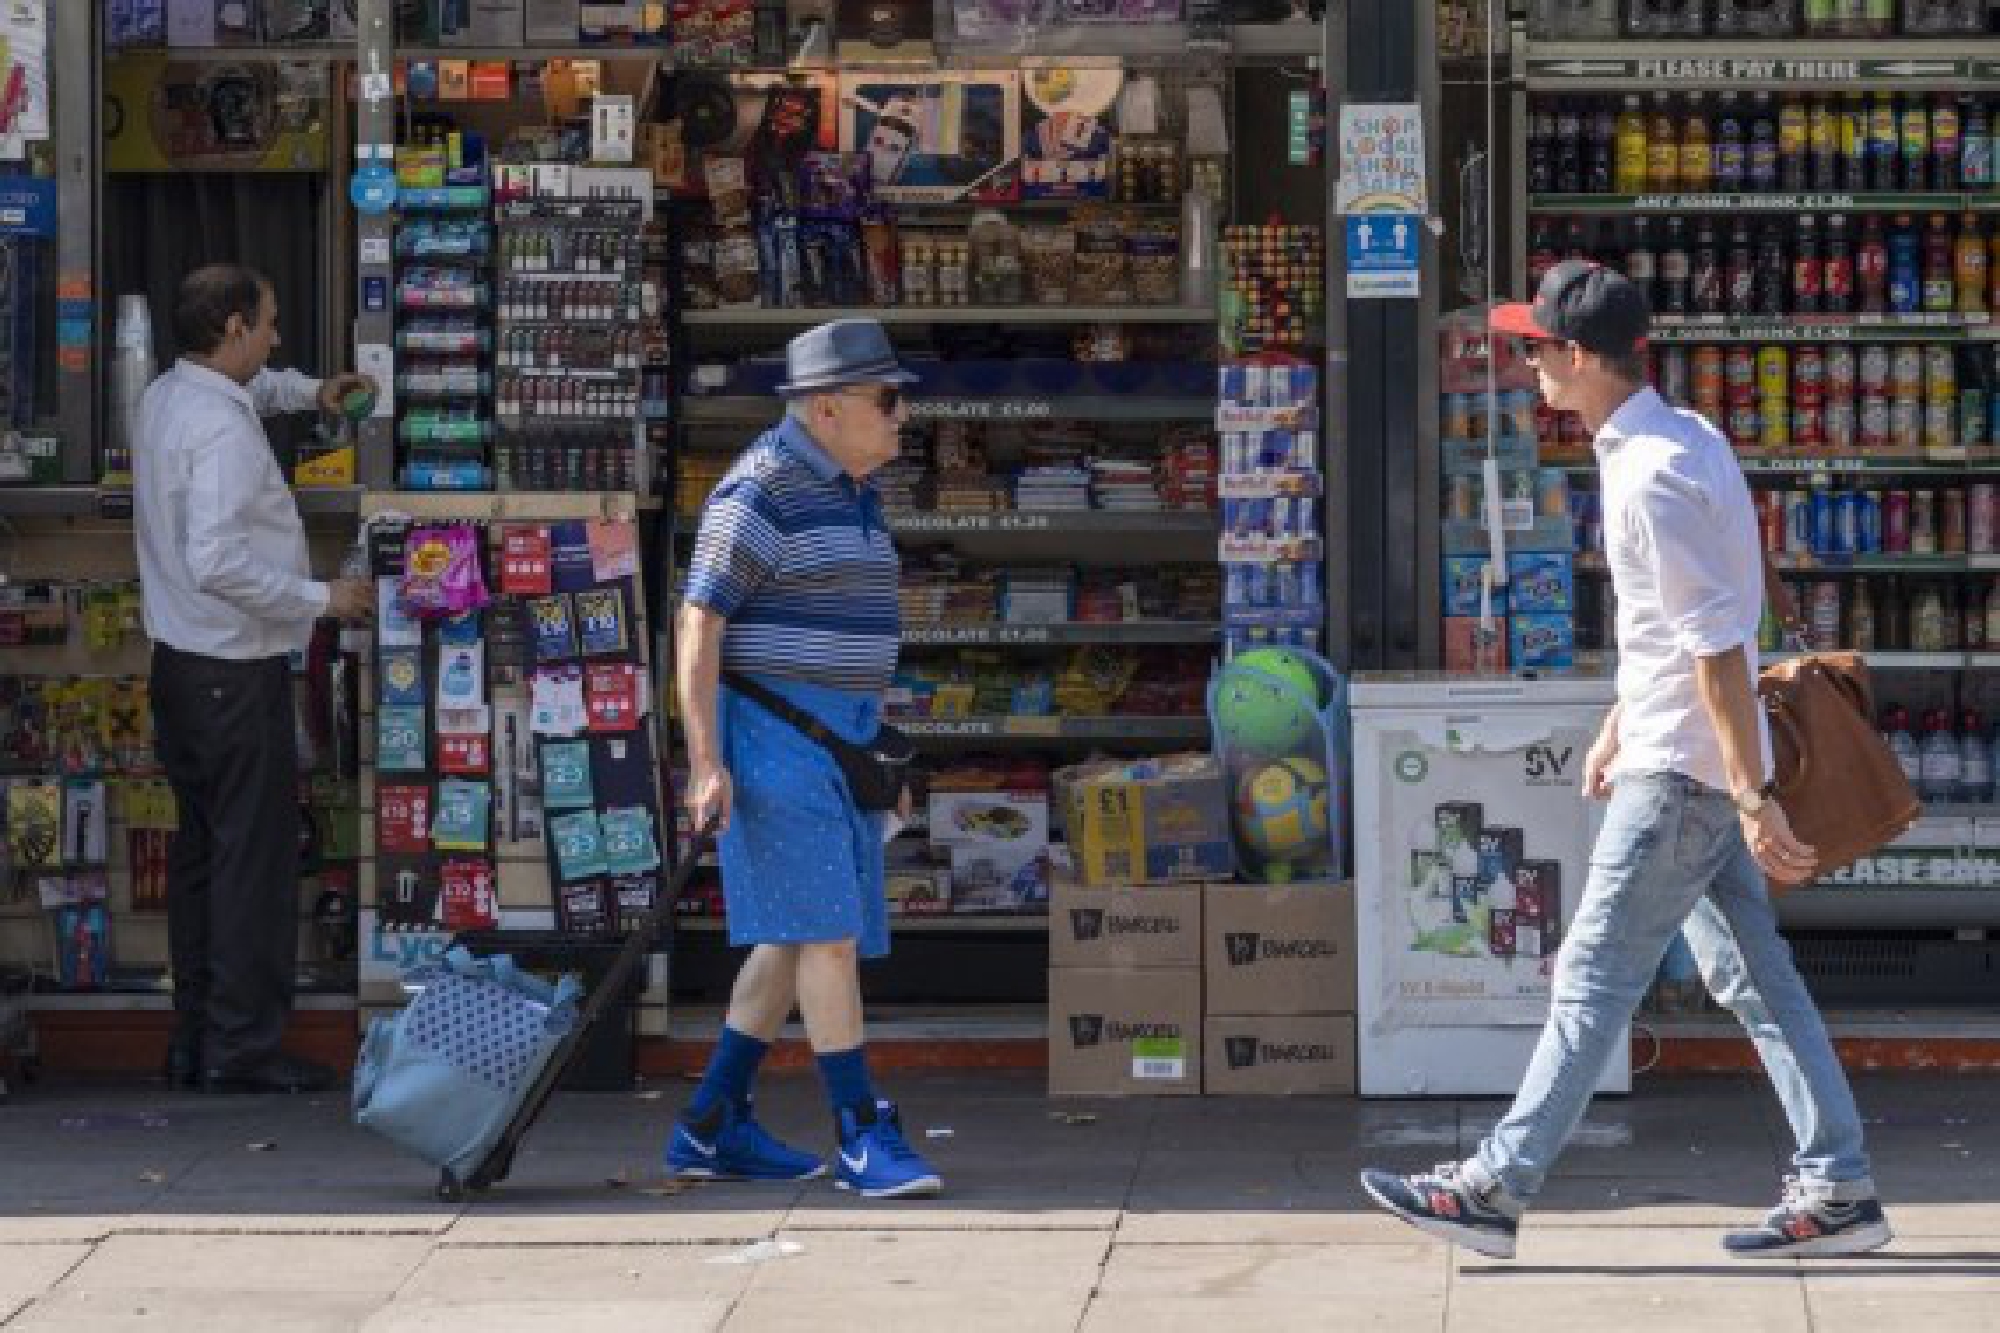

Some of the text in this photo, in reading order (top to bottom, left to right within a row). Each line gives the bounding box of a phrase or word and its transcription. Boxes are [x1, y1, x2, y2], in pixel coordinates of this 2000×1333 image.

[1639, 61, 1858, 78] PLEASE PAY THERE
[908, 402, 990, 415] OCOLATE
[1525, 747, 1573, 776] SV
